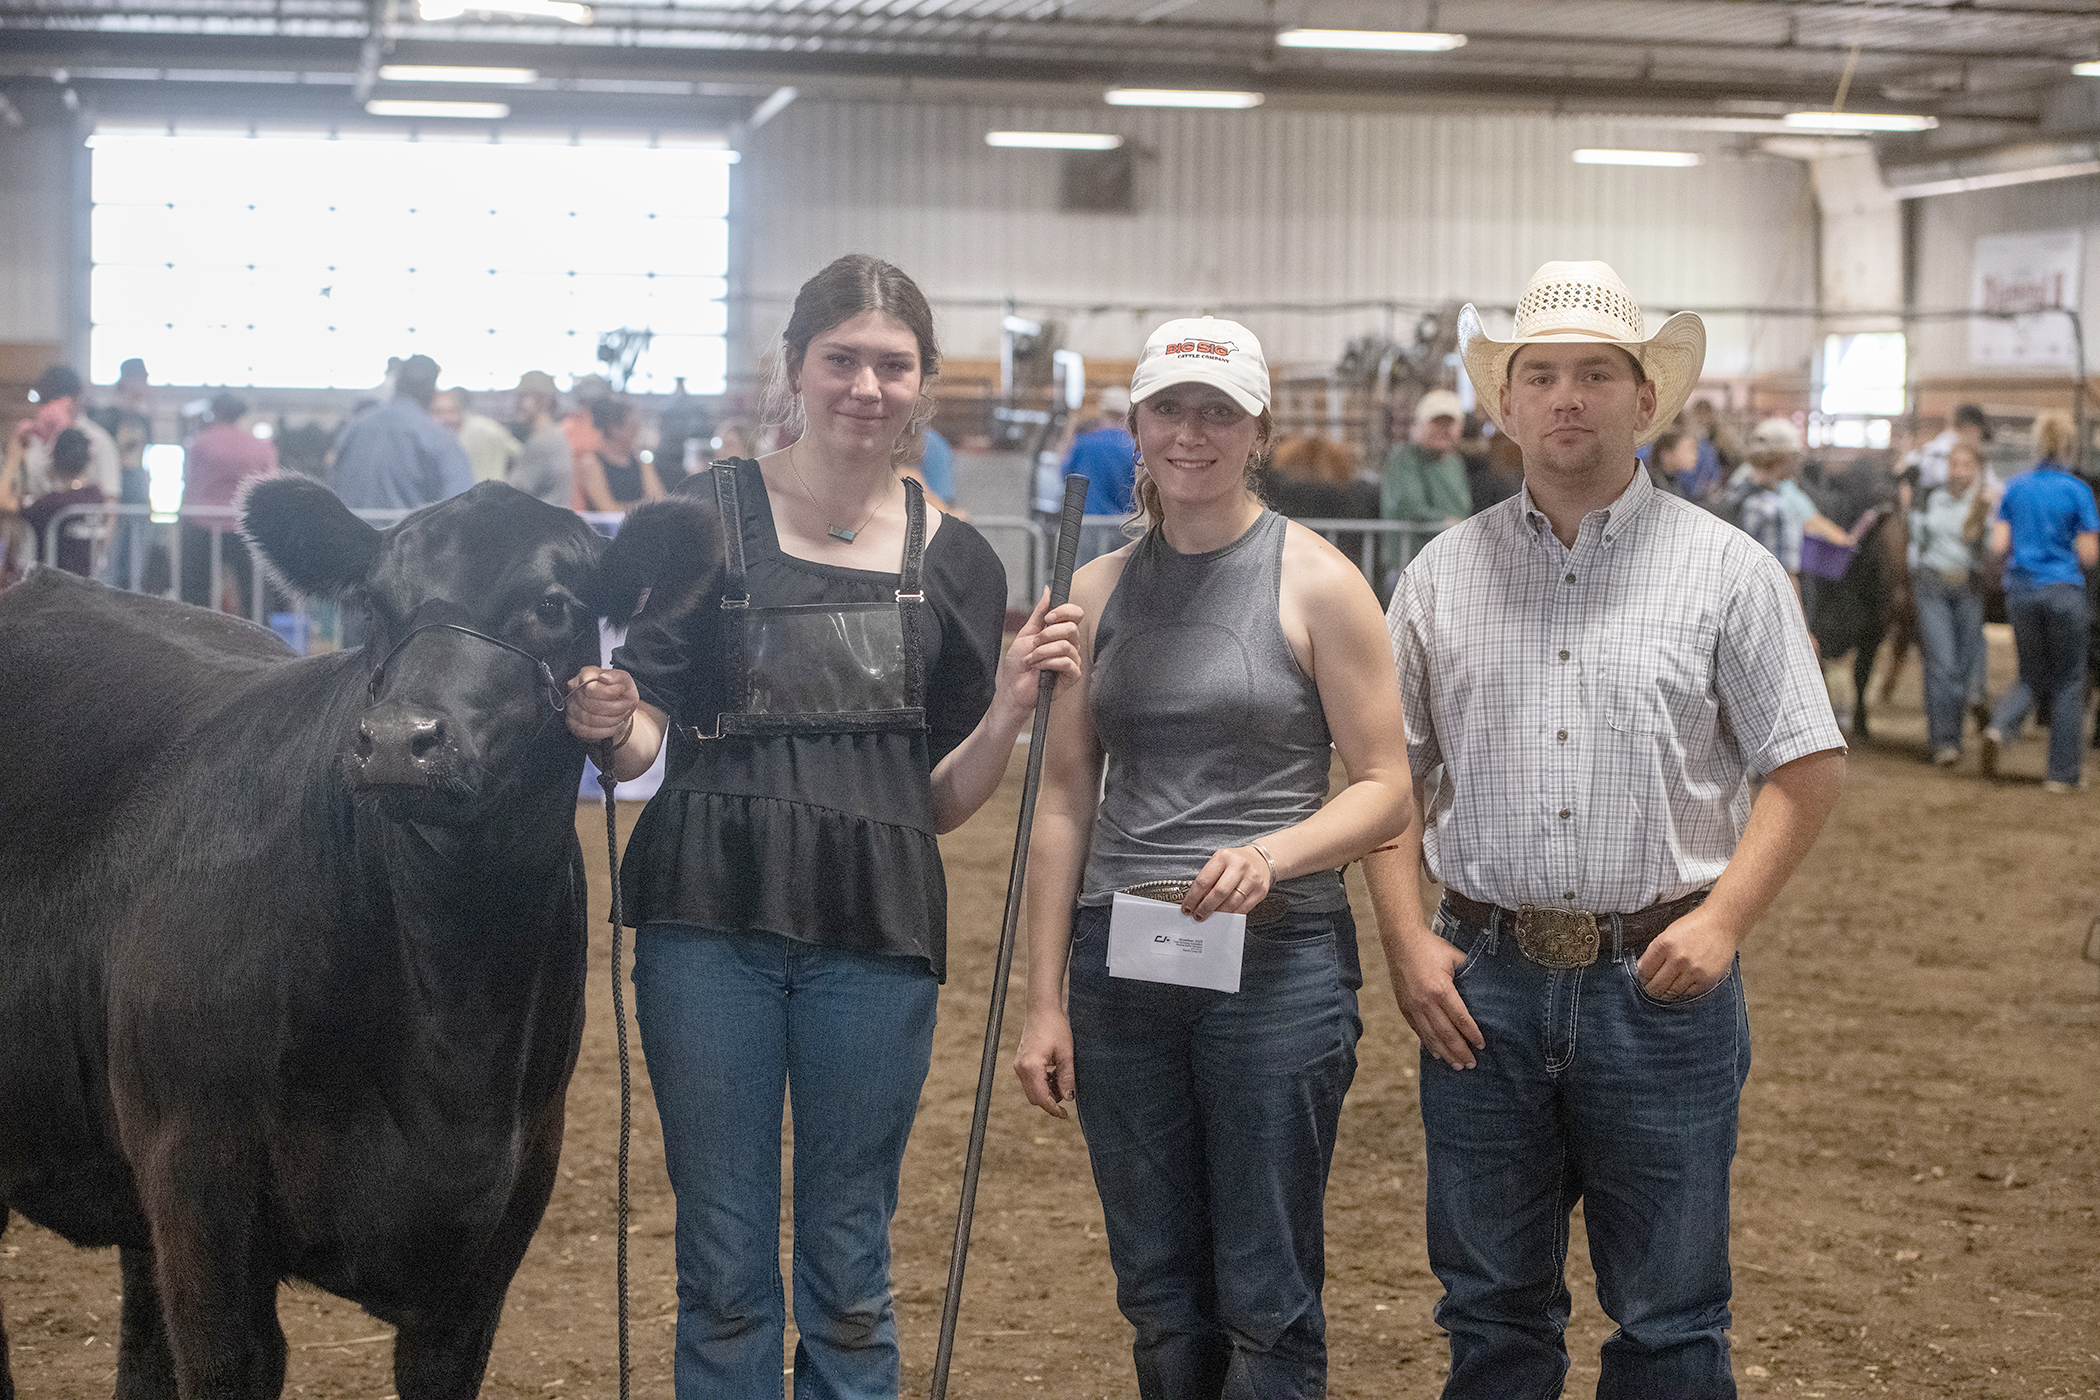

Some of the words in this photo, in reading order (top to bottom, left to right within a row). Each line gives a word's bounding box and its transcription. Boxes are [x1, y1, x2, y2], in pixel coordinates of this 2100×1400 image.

[1165, 342, 1195, 355] BIG
[1197, 342, 1228, 356] SIG
[1201, 354, 1229, 363] COMPANY
